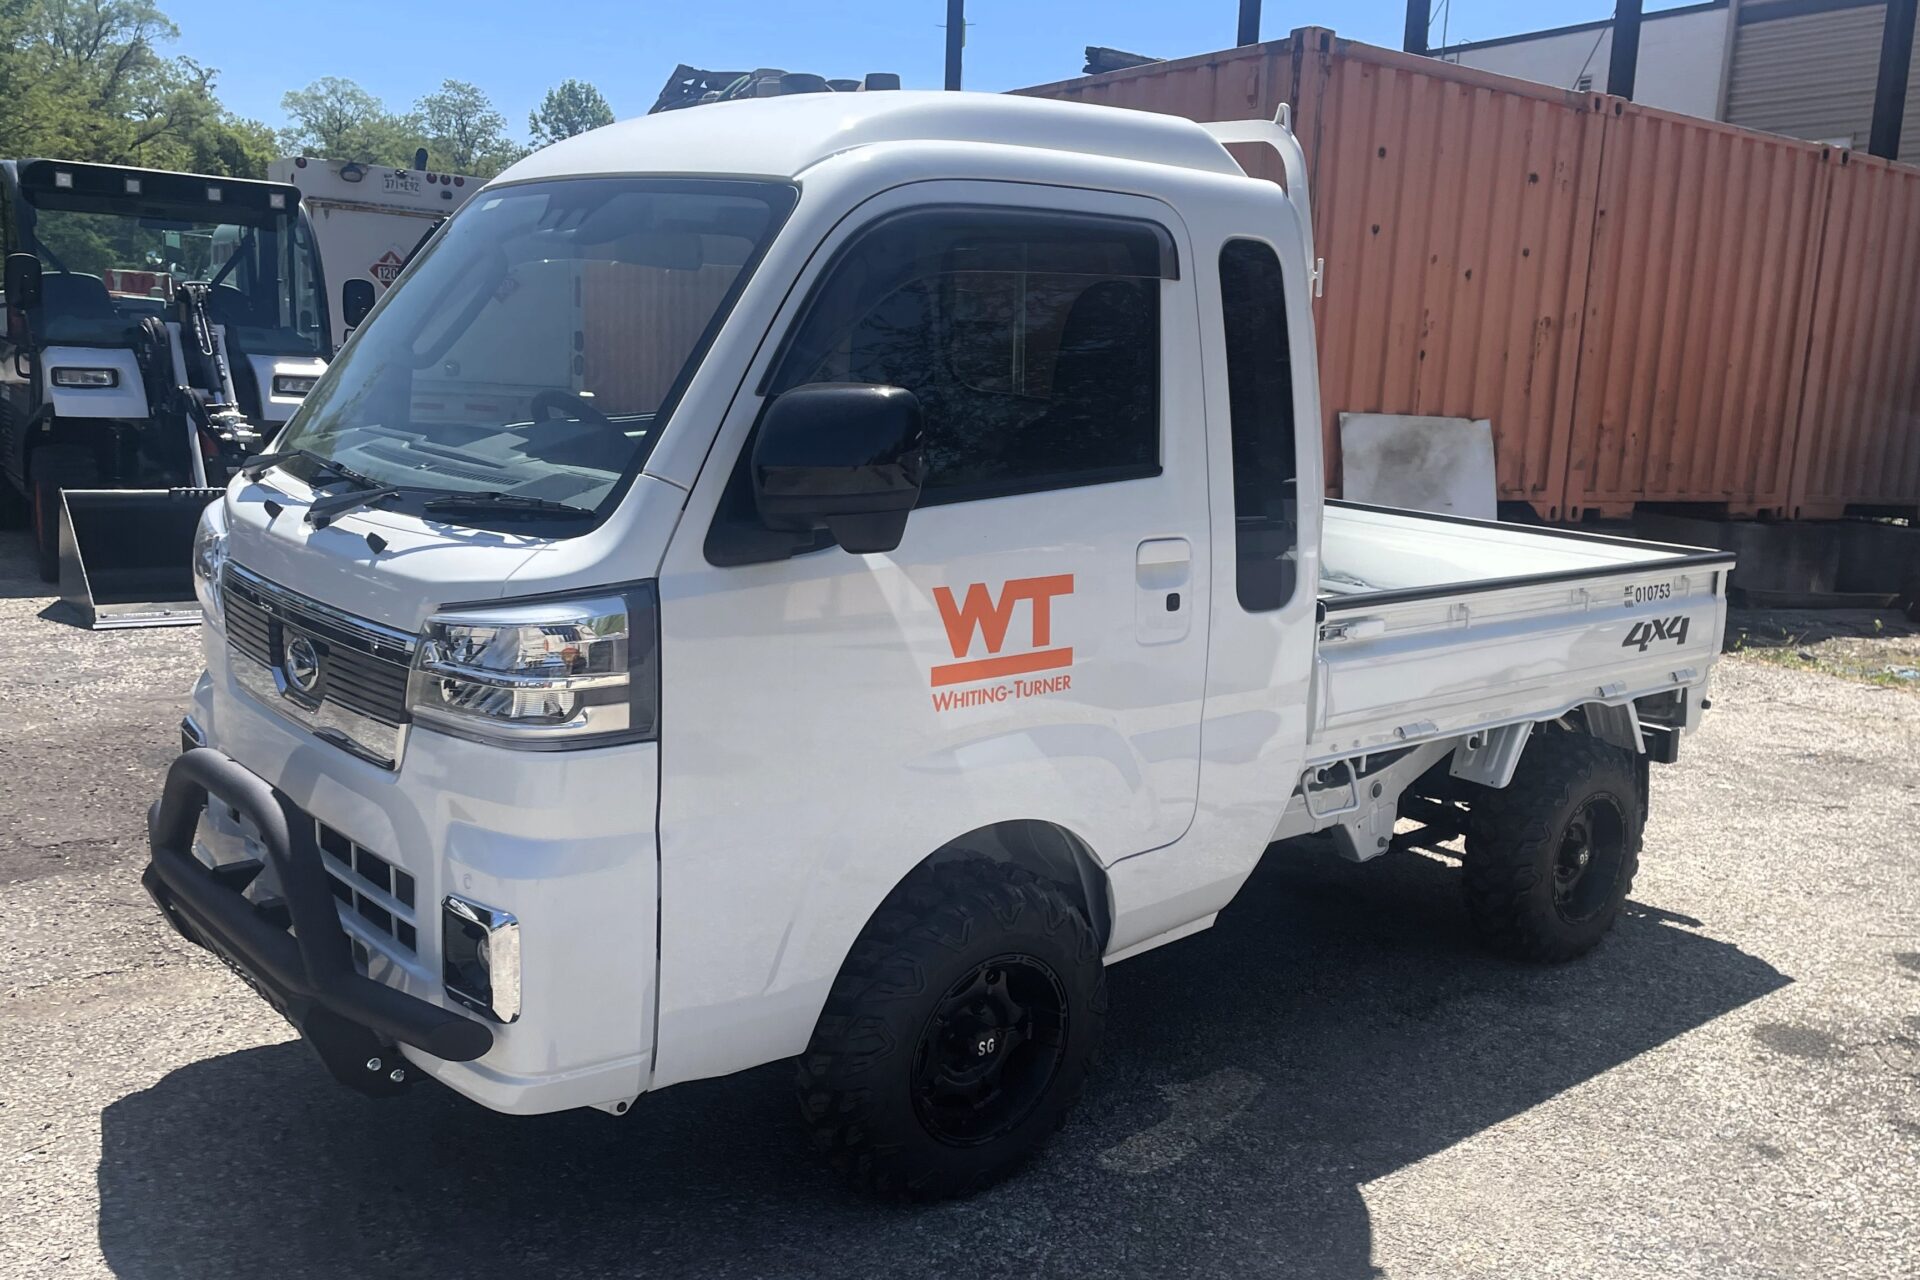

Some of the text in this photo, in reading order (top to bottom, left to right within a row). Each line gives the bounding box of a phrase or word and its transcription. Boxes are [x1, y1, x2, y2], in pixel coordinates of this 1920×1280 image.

[380, 267, 397, 280] 120
[1635, 583, 1671, 603] 010753
[931, 573, 1075, 659] WT
[931, 674, 1072, 713] WHITING-TURNER
[977, 1038, 994, 1056] SG
